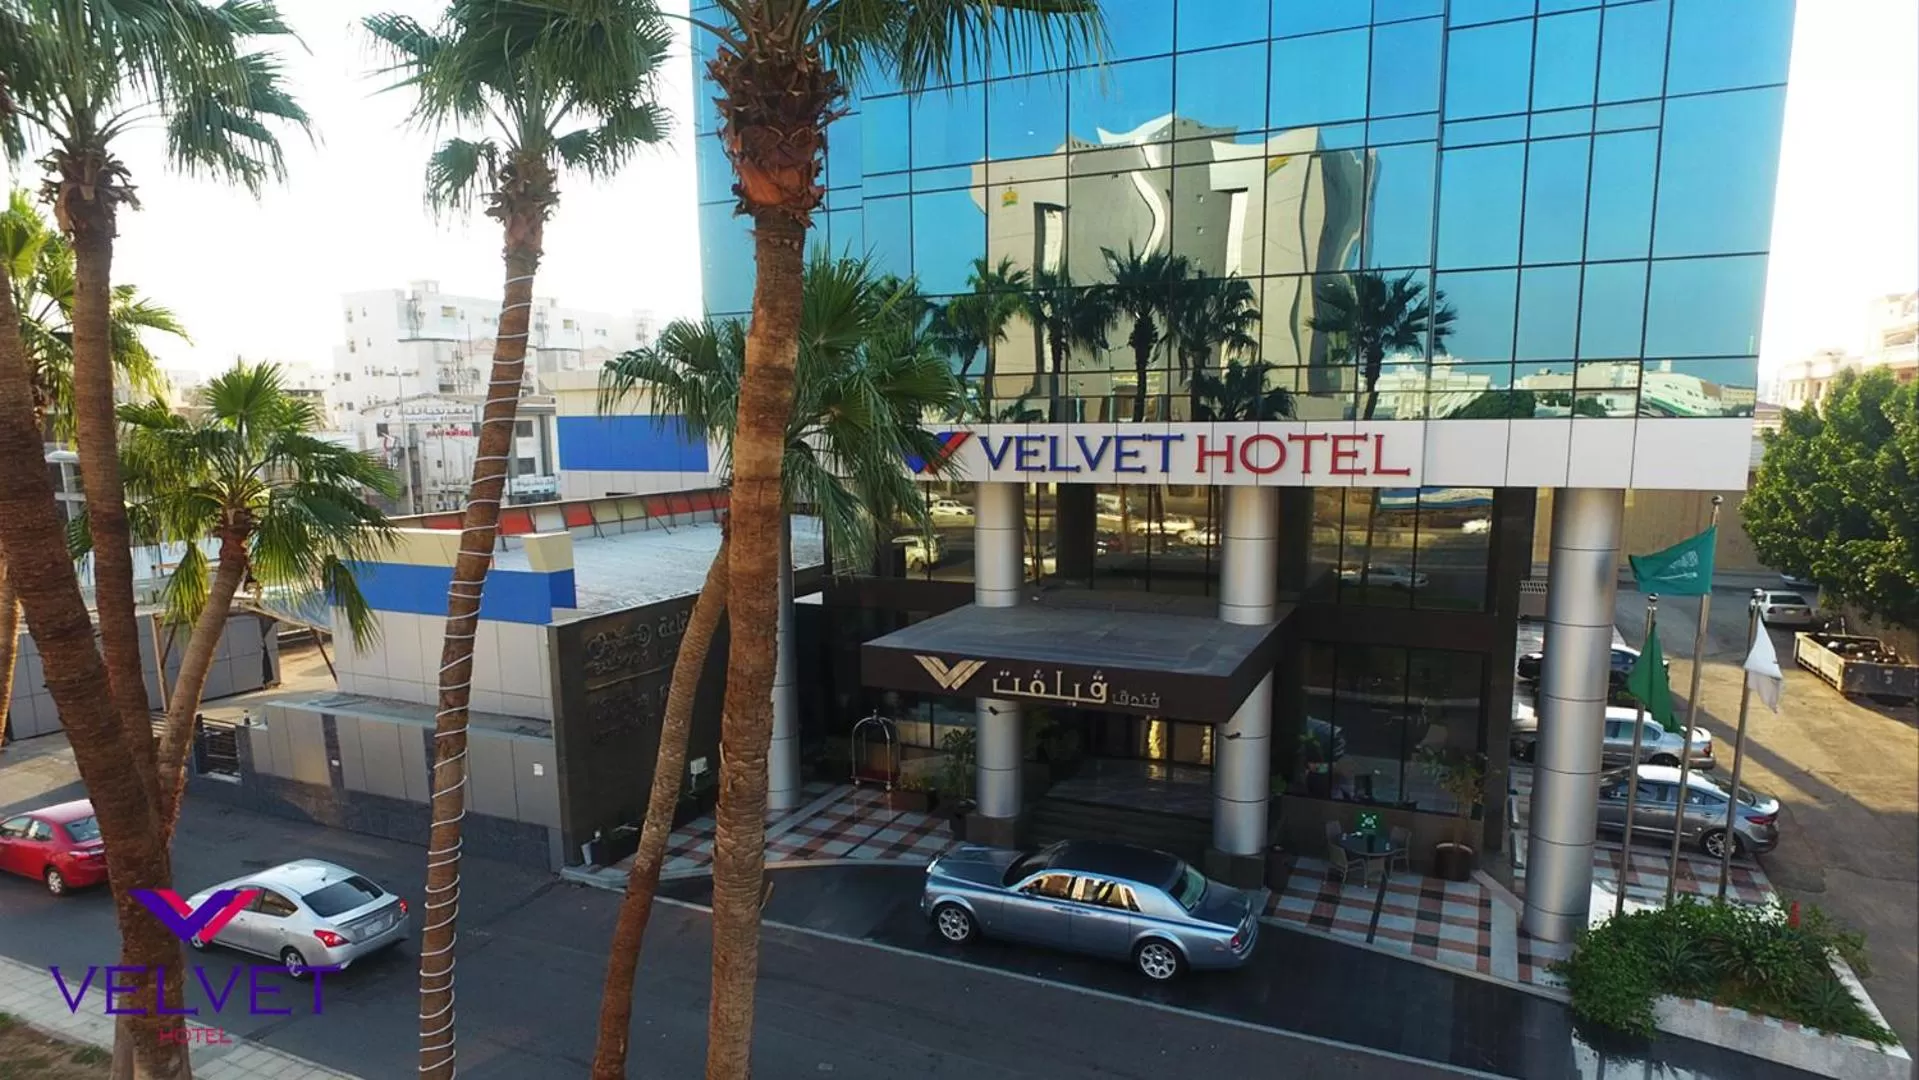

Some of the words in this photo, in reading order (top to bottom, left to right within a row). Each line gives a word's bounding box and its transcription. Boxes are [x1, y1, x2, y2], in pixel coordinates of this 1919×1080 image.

[978, 433, 1185, 473] VELVET
[1195, 433, 1411, 477] HOTEL
[1112, 689, 1160, 709] فندق
